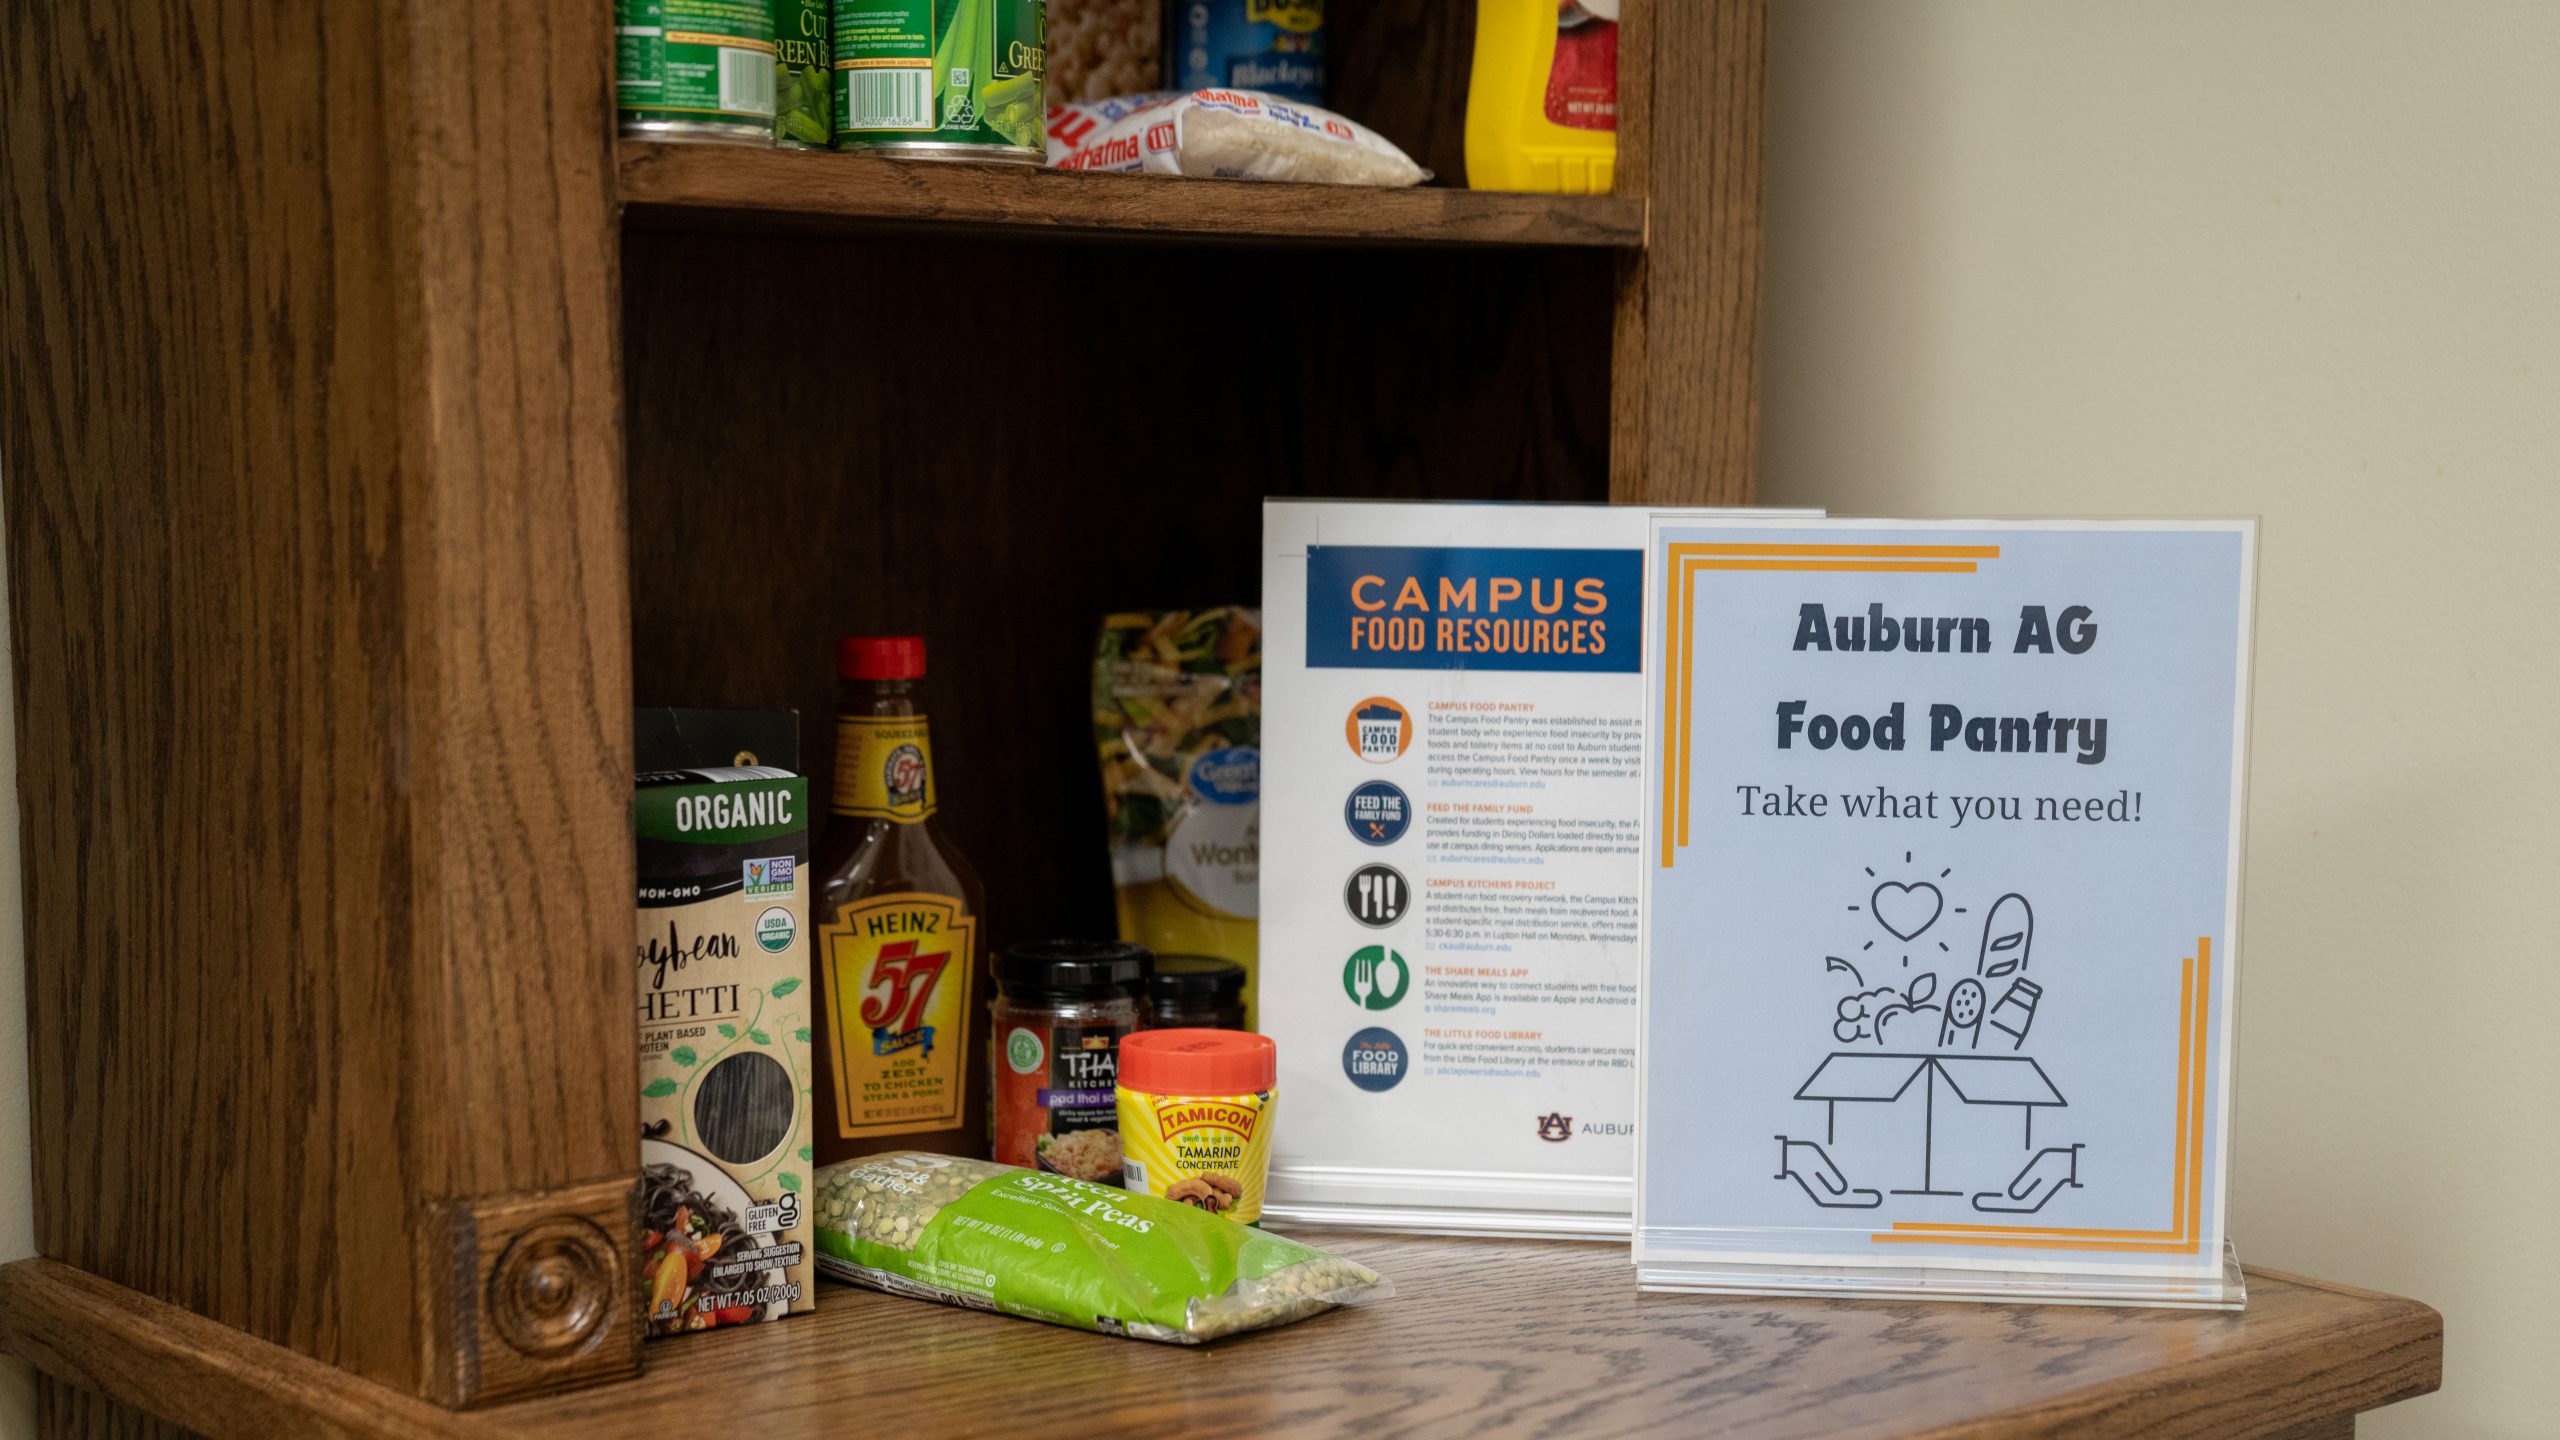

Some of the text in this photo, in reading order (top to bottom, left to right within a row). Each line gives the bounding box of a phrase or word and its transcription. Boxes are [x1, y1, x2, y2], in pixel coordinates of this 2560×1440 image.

[1351, 575, 1608, 615] CAMPUS
[1792, 602, 2098, 655] Auburn AG
[1351, 617, 1606, 654] FOOD RESOURCES
[1428, 702, 1535, 712] CAMPUS FOOD PANTRY
[1428, 714, 1444, 724] The
[1446, 715, 1478, 726] Campus
[1480, 716, 1502, 724] Food
[1504, 716, 1530, 727] Pantry
[1550, 718, 1597, 727] established
[1599, 718, 1608, 727] to
[1610, 718, 1632, 728] assist
[1362, 726, 1398, 734] CAMPUS
[1775, 700, 2108, 766] Food Pantry
[1362, 734, 1398, 745] FOOD
[1362, 745, 1397, 754] PANTRY
[1355, 796, 1401, 810] FEED THE
[1427, 804, 1533, 814] FEED THE FAMILY FUND
[1736, 785, 2142, 829] Take what you need!
[676, 789, 792, 832] ORGANIC
[1356, 810, 1401, 821] FAMILY FUND
[771, 860, 792, 869] NON
[771, 868, 792, 877] GMO
[747, 883, 793, 894] VERIFIED
[1426, 879, 1556, 890] CAMPUS KITCHENS PROJECT
[638, 885, 701, 898] NON-GMO
[1426, 892, 1431, 900] A
[1432, 891, 1477, 901] student-run
[1479, 892, 1497, 901] food
[1499, 894, 1532, 905] recovery
[1534, 894, 1568, 904] network,
[1570, 895, 1582, 903] the
[1584, 895, 1616, 906] Campus
[764, 918, 786, 928] USDA
[868, 911, 940, 937] HEINZ
[761, 930, 790, 941] ORGANIC
[1425, 966, 1529, 977] THE SHARE MEALS APP
[860, 940, 951, 1033] 57
[1425, 980, 1636, 993] An innovative way to connect students with free food
[1424, 991, 1447, 1000] Share
[1450, 992, 1474, 1001] Meals
[1476, 993, 1492, 1004] App
[1503, 994, 1539, 1002] available
[1553, 995, 1577, 1006] Apple
[1579, 996, 1594, 1004] and
[1596, 996, 1628, 1005] Android
[645, 1026, 706, 1042] PLANT BASED
[1424, 1029, 1542, 1040] THE LITTLE FOOD LIBRARY
[1353, 1050, 1399, 1062] FOOD
[1060, 1053, 1119, 1079] THA
[1353, 1062, 1398, 1075] LIBRARY
[882, 1068, 927, 1078] ZEST
[864, 1078, 944, 1091] TO CHICKEN
[1050, 1094, 1074, 1106] pad
[1078, 1093, 1100, 1104] thai
[1162, 1107, 1252, 1131] TAMICON
[1176, 1146, 1241, 1158] TAMARIND
[1176, 1160, 1239, 1170] CONCENTRATE
[850, 1168, 916, 1195] Gather
[1039, 1172, 1128, 1202] reen
[991, 1189, 1040, 1206] Excellent
[749, 1206, 778, 1221] GLUTEN
[1081, 1199, 1155, 1233] Peas
[749, 1221, 766, 1232] FREE
[737, 1243, 800, 1262] SERVING SUGGESTION
[713, 1254, 800, 1278] ENLARGED TO SHOW TEXTURE
[698, 1282, 801, 1312] NET WT 7.05 OZ (200g)
